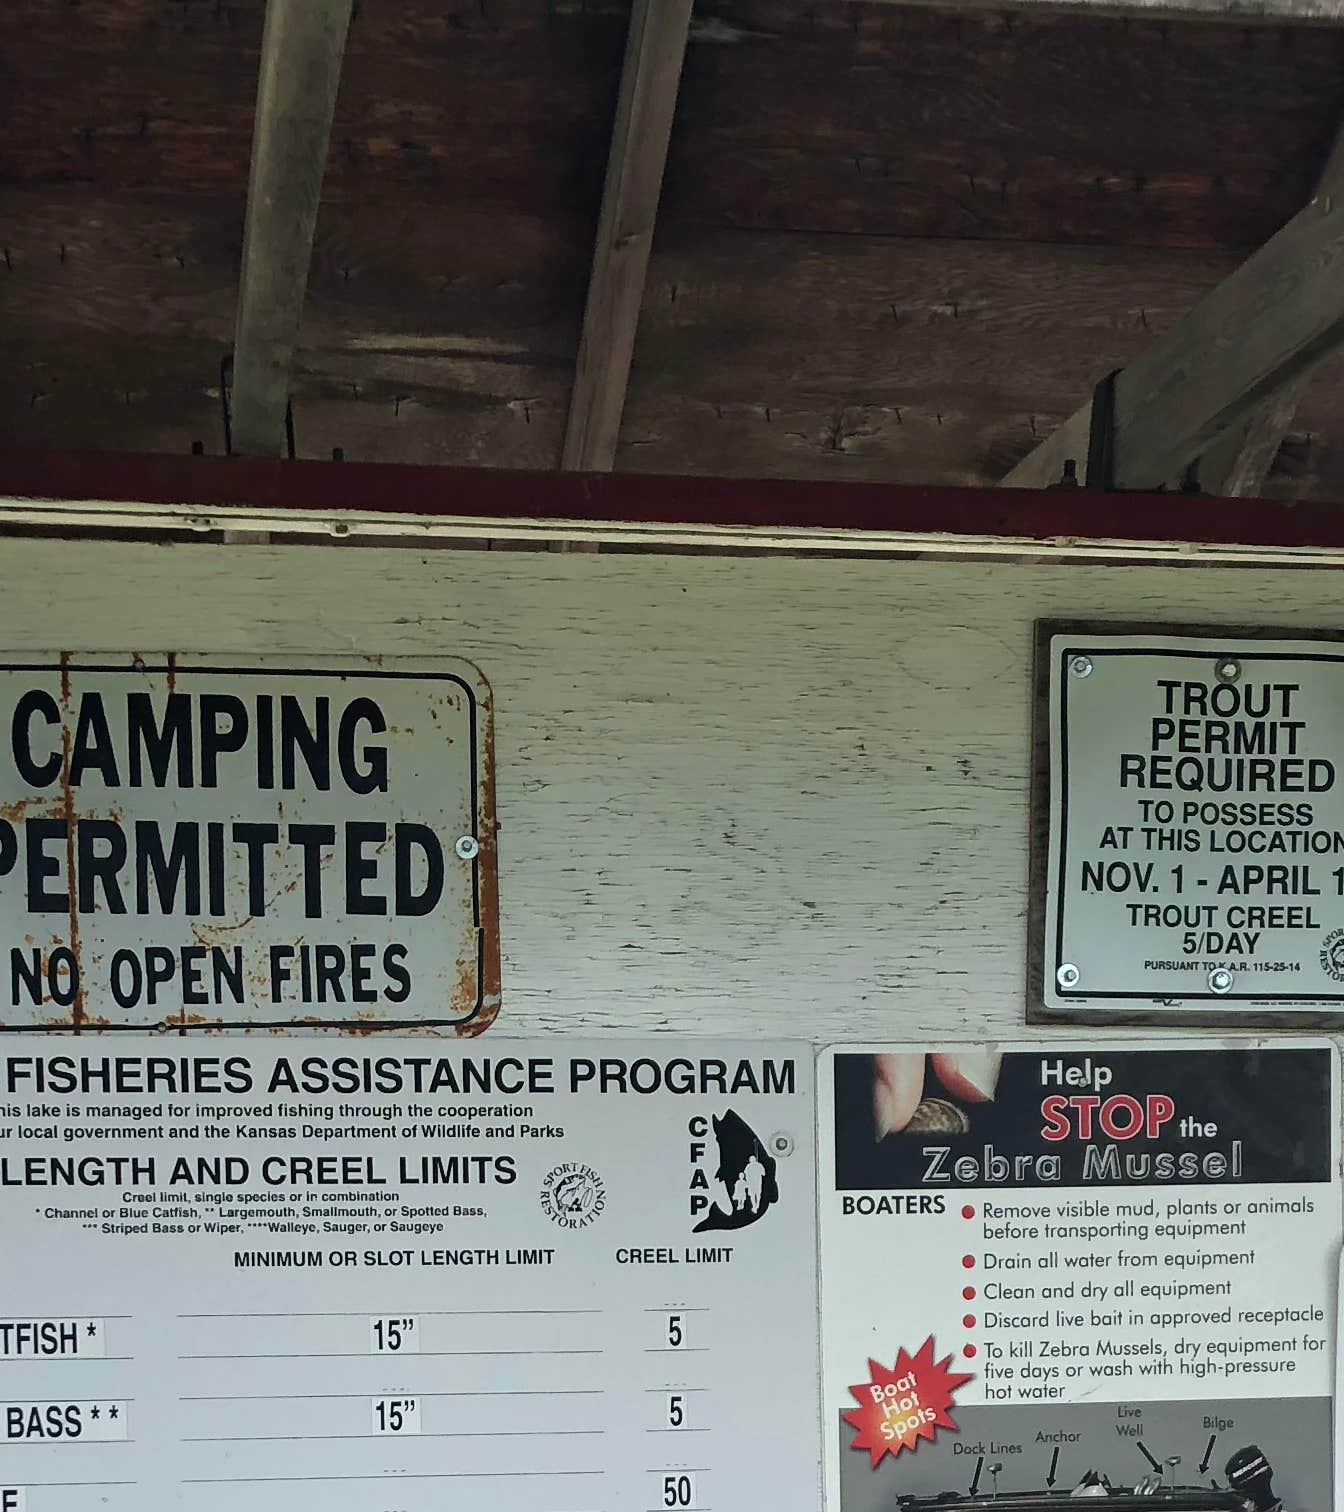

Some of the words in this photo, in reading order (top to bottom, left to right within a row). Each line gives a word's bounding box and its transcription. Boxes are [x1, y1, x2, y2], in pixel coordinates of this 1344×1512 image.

[1157, 680, 1299, 718] TROUT
[11, 689, 388, 794] CAMPING
[1151, 718, 1305, 755] PERMIT
[1120, 754, 1335, 792] REQUIRED
[1138, 800, 1173, 823] TO
[1183, 802, 1313, 826] POSSESS
[1100, 827, 1133, 849] AT
[1142, 829, 1200, 852] THIS
[1081, 861, 1158, 893] NOV.
[1172, 865, 1184, 893] 1
[1217, 866, 1320, 894] APRIL
[1127, 904, 1217, 928] TROUT
[1227, 906, 1320, 928] CREEL
[1183, 932, 1261, 954] 5/DAY
[10, 946, 79, 1006] NO
[110, 946, 242, 1008] OPEN
[270, 944, 410, 1004] FIRES
[1144, 961, 1199, 970] PURSUANT
[1253, 962, 1300, 972] 115-25-14
[7, 1058, 253, 1094] FISHERIES
[268, 1058, 554, 1094] ASSISTANCE
[570, 1059, 795, 1094] PROGRAM
[1041, 1058, 1112, 1091] Help
[27, 1104, 60, 1117] lake
[86, 1104, 162, 1120] managed
[168, 1104, 190, 1117] for
[197, 1104, 272, 1120] improved
[278, 1104, 334, 1120] fishing
[339, 1104, 402, 1120] through
[407, 1104, 432, 1117] the
[438, 1104, 533, 1120] cooperation
[1041, 1095, 1175, 1141] STOP
[19, 1125, 58, 1139] local
[64, 1126, 163, 1141] government
[169, 1125, 199, 1138] and
[204, 1125, 230, 1138] the
[237, 1125, 296, 1138] Kansas
[303, 1125, 396, 1141] Department
[421, 1125, 480, 1138] Wildlife
[485, 1125, 515, 1138] and
[520, 1125, 564, 1138] Parks
[1180, 1118, 1217, 1137] the
[1, 1157, 155, 1186] LENGTH
[170, 1157, 249, 1184] AND
[262, 1157, 386, 1185] CREEL
[400, 1156, 517, 1184] LIMITS
[922, 1144, 1061, 1182] Zebra
[1083, 1141, 1241, 1180] Mussel
[322, 1191, 399, 1201] combination
[842, 1196, 945, 1215] BOATERS
[984, 1203, 1050, 1218] Remove
[1057, 1201, 1109, 1217] visible
[1116, 1200, 1159, 1219] mud,
[1167, 1199, 1217, 1218] plants
[1247, 1197, 1314, 1213] animals
[45, 1208, 98, 1218] Channel
[120, 1208, 148, 1218] Blue
[153, 1207, 201, 1220] Catfish,
[220, 1207, 299, 1220] Largemouth,
[303, 1207, 382, 1218] Smallmouth,
[401, 1206, 449, 1219] Spotted
[454, 1207, 487, 1218] Bass,
[984, 1223, 1039, 1239] before
[1045, 1221, 1148, 1241] transporting
[1155, 1221, 1246, 1239] equipment
[234, 1251, 322, 1268] MINIMUM
[329, 1250, 357, 1267] OR
[364, 1250, 415, 1267] SLOT
[421, 1249, 500, 1266] LENGTH
[506, 1249, 555, 1266] LIMIT
[615, 1248, 679, 1264] CREEL
[686, 1247, 734, 1264] LIMIT
[984, 1254, 1031, 1269] Drain
[1038, 1252, 1058, 1268] all
[1064, 1254, 1112, 1268] water
[1118, 1251, 1158, 1267] from
[1164, 1251, 1255, 1269] equipment
[984, 1283, 1035, 1299] Clean
[1042, 1282, 1074, 1298] and
[1081, 1282, 1108, 1301] dry
[1114, 1280, 1134, 1297] all
[1141, 1280, 1231, 1298] equipment
[984, 1311, 1049, 1328] Discard
[1056, 1311, 1084, 1326] live
[1091, 1309, 1123, 1325] bait
[1150, 1308, 1231, 1328] approved
[1238, 1306, 1324, 1323] receptacle
[668, 1316, 682, 1346] 5
[984, 1343, 1003, 1359] To
[1009, 1341, 1032, 1358] kill
[1039, 1340, 1090, 1357] Zebra
[1096, 1338, 1167, 1358] Mussels,
[1174, 1338, 1201, 1357] dry
[1207, 1336, 1297, 1356] equipment
[1303, 1335, 1326, 1351] for
[984, 1363, 1014, 1379] five
[1020, 1362, 1059, 1381] days
[1089, 1359, 1133, 1377] wash
[1139, 1359, 1173, 1375] with
[1180, 1357, 1296, 1378] high-pressure
[870, 1372, 918, 1403] Boat
[985, 1383, 1012, 1399] hot
[1018, 1385, 1066, 1398] water
[669, 1396, 682, 1426] 5
[882, 1392, 920, 1419] Hot
[1118, 1406, 1142, 1418] Live
[7, 1406, 82, 1437] BASS
[880, 1407, 937, 1441] Spots
[1116, 1424, 1143, 1436] Well
[1203, 1416, 1234, 1431] Bilge
[953, 1442, 986, 1455] Dock
[990, 1441, 1022, 1454] Lines
[1035, 1431, 1082, 1443] Anchor
[664, 1476, 691, 1506] 50
